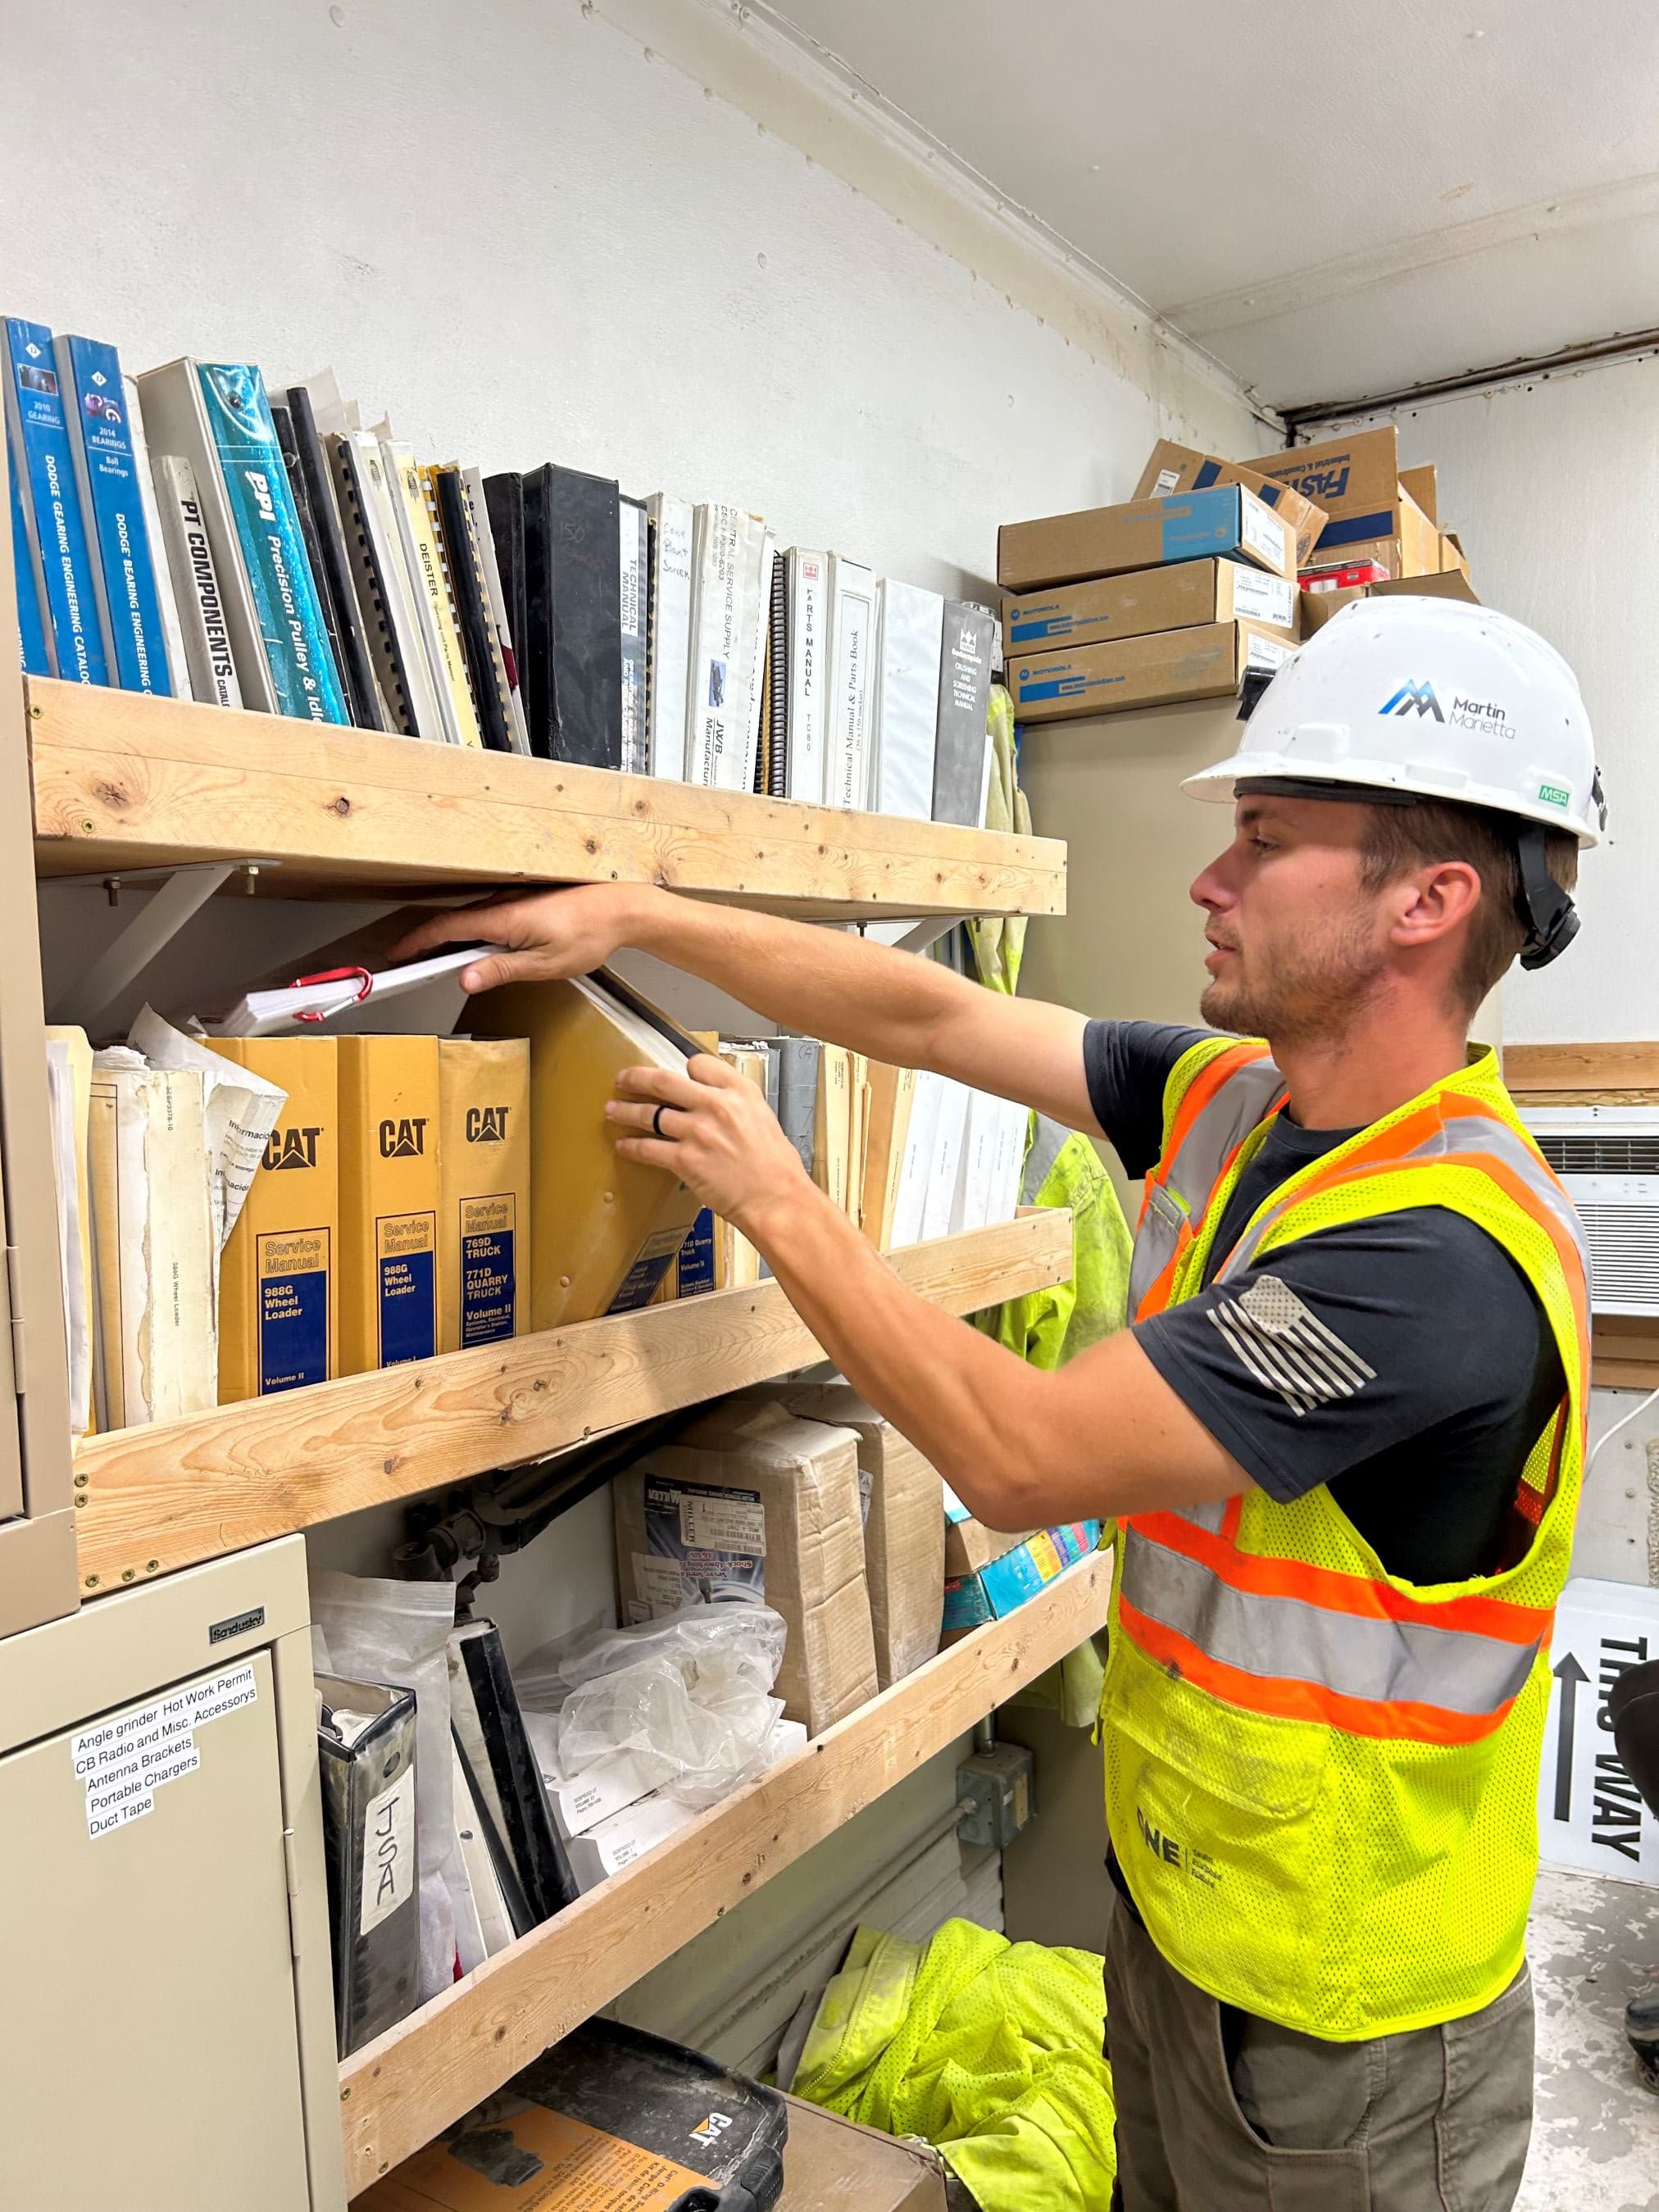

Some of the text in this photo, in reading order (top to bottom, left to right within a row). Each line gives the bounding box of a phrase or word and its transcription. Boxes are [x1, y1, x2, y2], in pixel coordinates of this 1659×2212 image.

[28, 410, 61, 425] GEARING
[99, 427, 116, 436] 2014
[92, 435, 126, 449] BEARINGS
[106, 456, 119, 466] Ball
[1315, 454, 1351, 468] Industrial
[46, 454, 61, 498] DODGE
[99, 464, 129, 477] Bearings
[180, 500, 202, 527] PT
[52, 502, 69, 554] GEARING
[420, 543, 439, 597] DEISTER
[244, 470, 276, 522] PPI
[267, 534, 296, 615] Precision
[289, 620, 311, 672] Pulley
[303, 677, 317, 690] &
[725, 562, 734, 613] SERVICE
[61, 557, 83, 633] ENGINEERING
[116, 513, 130, 554] DODGE
[123, 559, 139, 608] BEARING
[131, 611, 152, 686] ENGINEERING
[630, 559, 638, 631] TECHNICAL
[189, 533, 233, 677] COMPONENTS
[1023, 604, 1060, 615] MOTOROLA
[721, 615, 733, 660] SUPPLY
[805, 638, 813, 697] MANUAL
[1033, 664, 1072, 675] MOTOROLA
[952, 680, 977, 693] SCREENING
[961, 674, 970, 683] AND
[953, 689, 975, 703] TECHNICAL
[955, 699, 974, 711] MANUAL
[843, 629, 858, 806] Technical Manual & Parts Book
[1453, 697, 1506, 721] Martin
[1448, 711, 1516, 740] Marietta
[715, 720, 725, 754] JWB
[1541, 788, 1569, 805] MSA
[466, 1106, 508, 1142] CAT
[380, 1118, 426, 1158] CAT
[261, 1128, 320, 1170] CAT
[466, 1202, 508, 1219] Service
[384, 1220, 430, 1238] Service
[466, 1216, 507, 1233] Manual
[266, 1238, 321, 1256] Service
[384, 1234, 428, 1253] Manual
[466, 1237, 492, 1249] 769D
[682, 1238, 711, 1249] 71D Quarry
[466, 1246, 502, 1259] TRUCK
[266, 1254, 320, 1274] Manual
[384, 1264, 407, 1276] 988G
[680, 1262, 700, 1272] Volume
[384, 1274, 412, 1287] Wheel
[466, 1268, 492, 1280] 771D
[467, 1274, 508, 1290] QUARRY
[264, 1285, 293, 1297] 988G
[385, 1285, 416, 1297] Loader
[467, 1287, 502, 1301] TRUCK
[265, 1295, 298, 1310] Wheel
[266, 1308, 303, 1321] Loader
[466, 1303, 511, 1321] Volume II
[266, 1372, 305, 1386] Volume II
[212, 1615, 263, 1641] Sandusky
[77, 1669, 252, 1752] Angle grinder Hot Work Permit
[75, 1688, 257, 1774] CB Radio and Misc. Accessorys
[87, 1737, 193, 1792] Antenna Brackets
[90, 1756, 198, 1813] Portable Chargers
[89, 1798, 152, 1835] Duct Tape
[1592, 1754, 1643, 1864] WAY
[375, 1796, 400, 1906] JSA
[689, 2113, 734, 2150] CAT
[648, 2161, 659, 2170] Kit
[604, 2190, 627, 2210] torique
[626, 2195, 636, 2203] de
